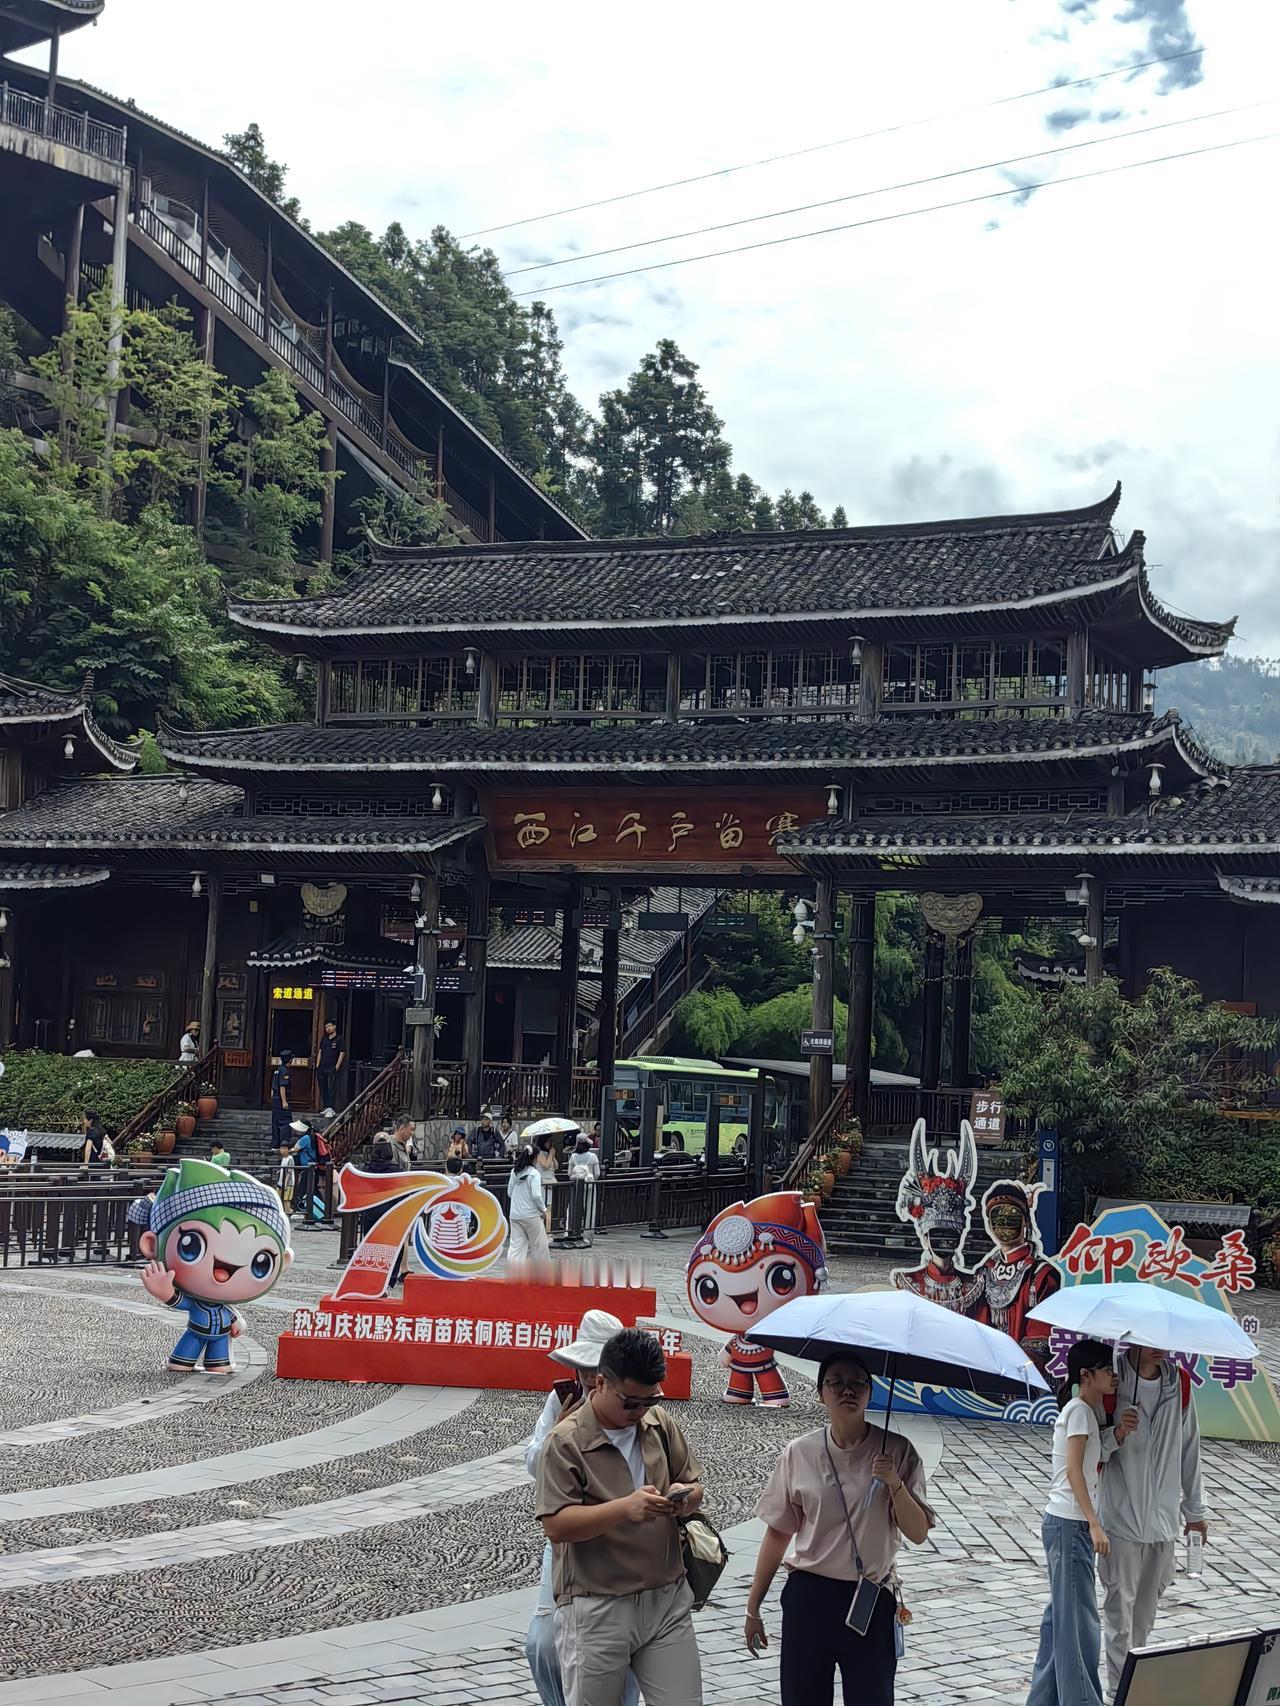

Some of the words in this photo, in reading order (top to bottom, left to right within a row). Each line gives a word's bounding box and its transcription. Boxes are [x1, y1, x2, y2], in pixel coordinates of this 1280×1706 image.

[976, 1100, 1002, 1114] 步行
[974, 1117, 1000, 1130] 通道
[1060, 1225, 1255, 1291] 仰欧桑
